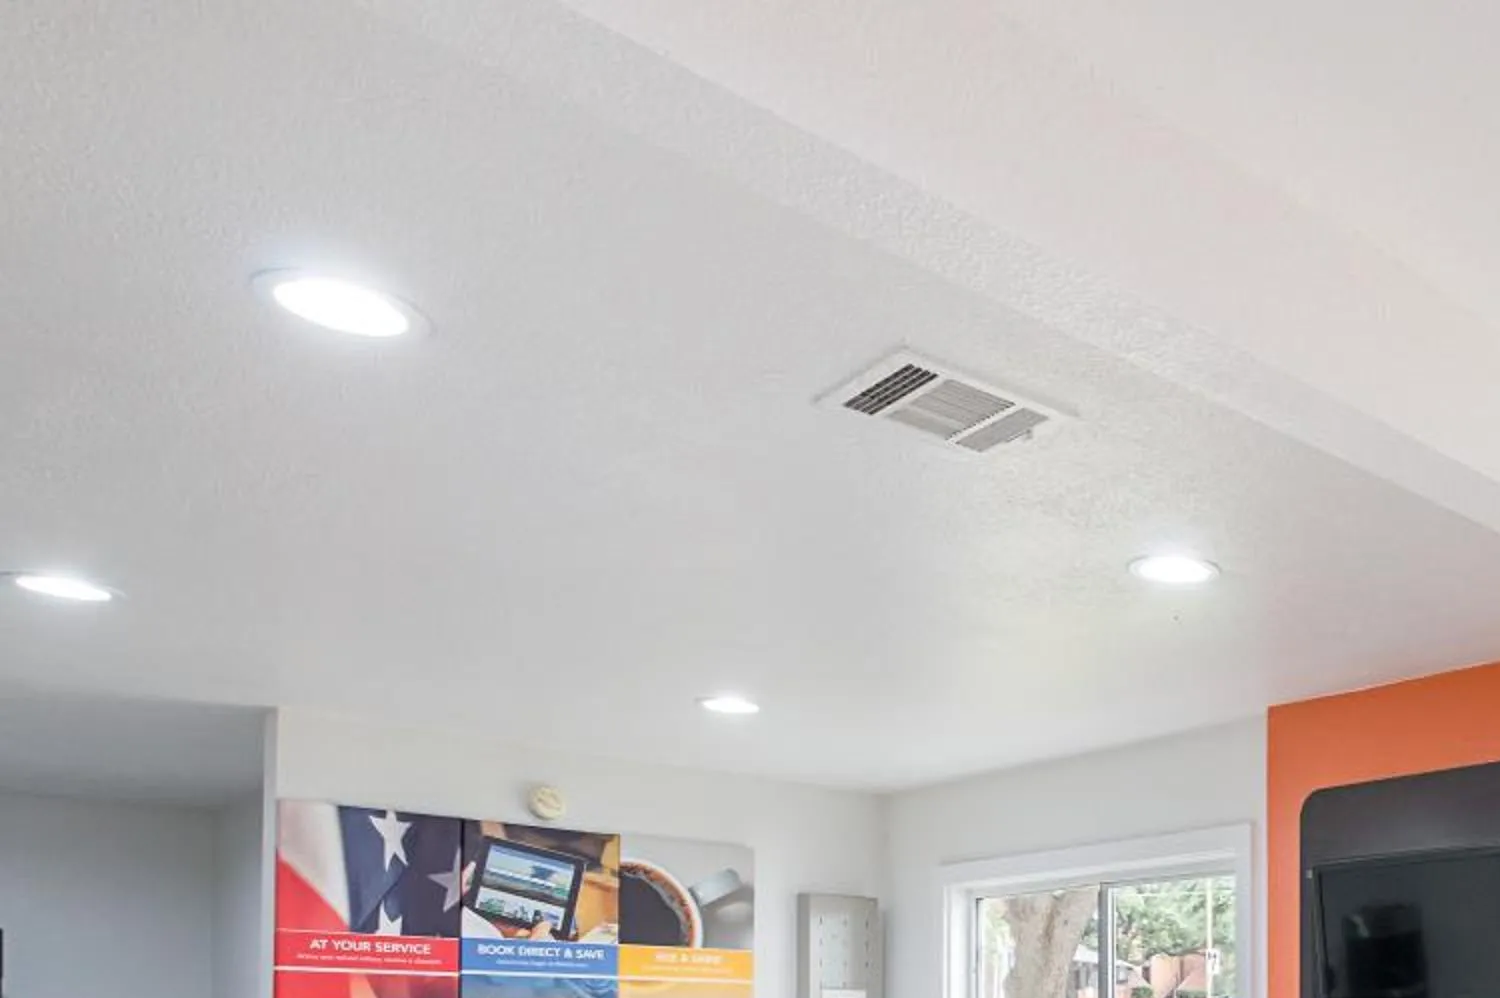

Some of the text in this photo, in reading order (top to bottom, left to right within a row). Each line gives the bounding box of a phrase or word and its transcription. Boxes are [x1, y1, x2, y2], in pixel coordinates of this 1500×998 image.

[309, 938, 432, 955] AT YOUR SERVICE
[477, 943, 514, 955] BOOK
[518, 945, 561, 957] DIRECT
[576, 949, 605, 960] SAVE
